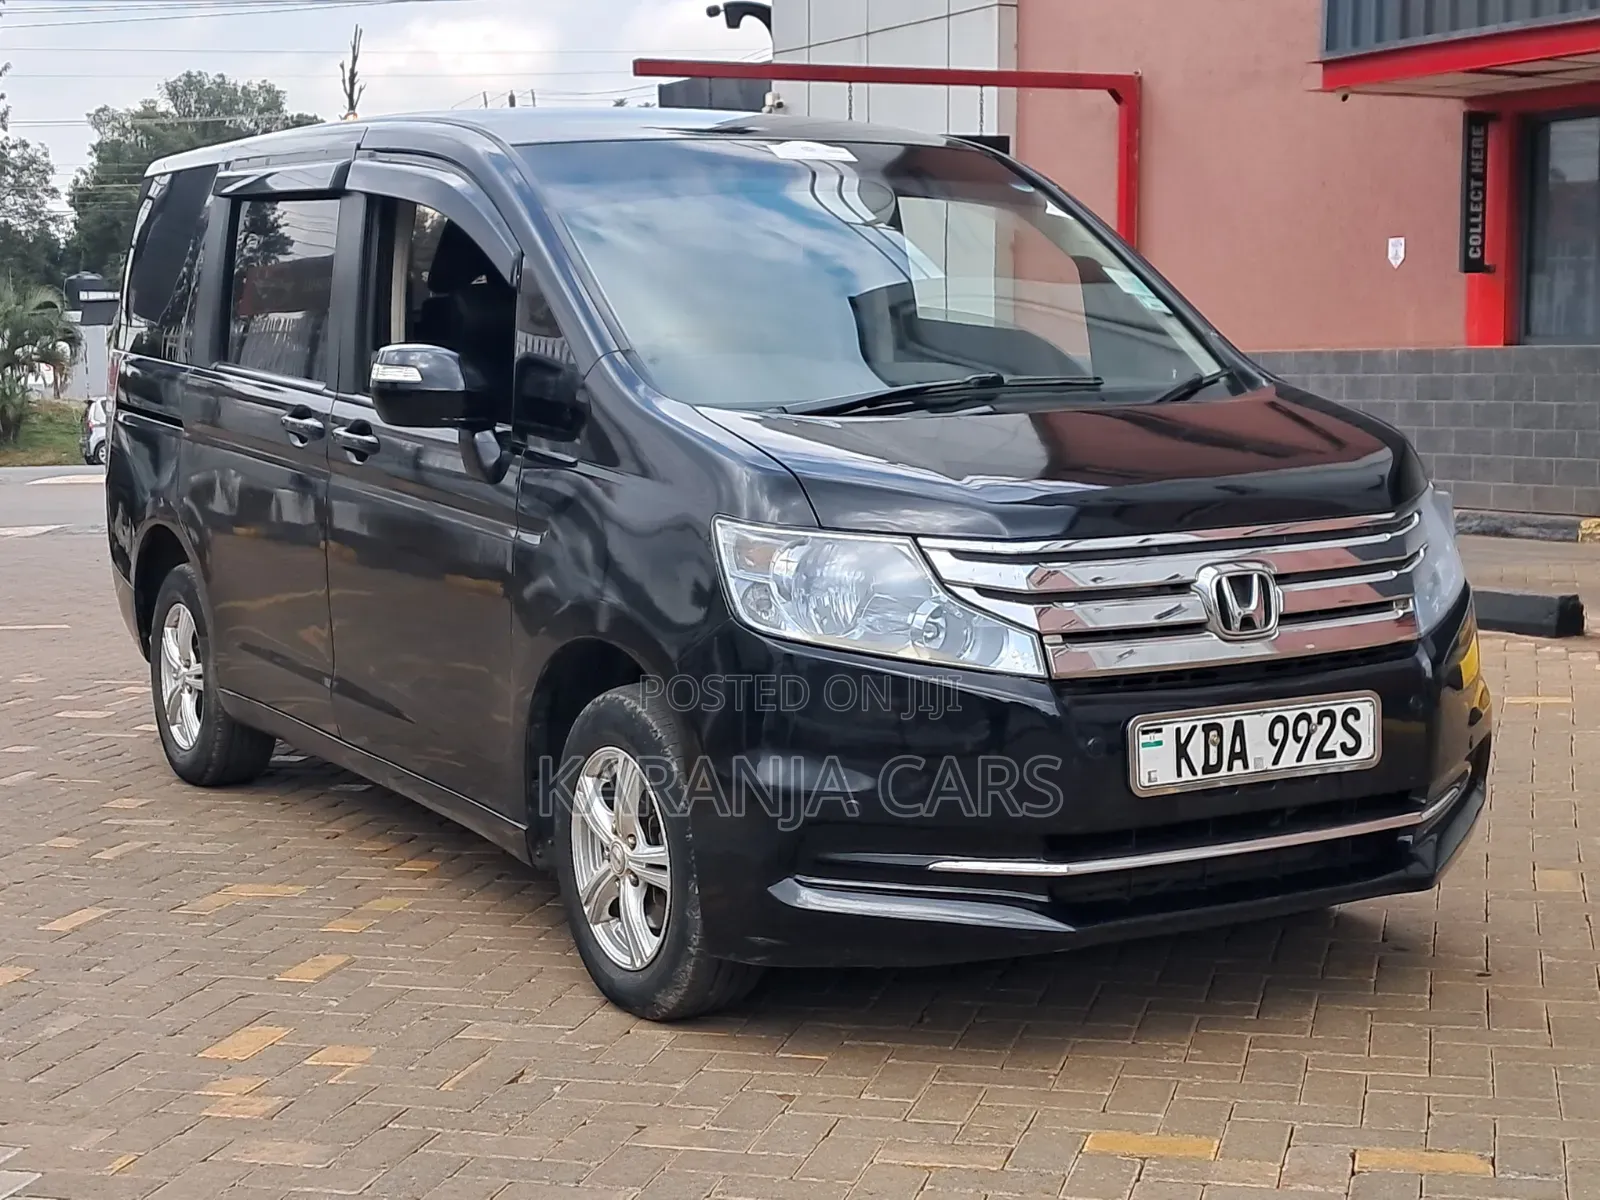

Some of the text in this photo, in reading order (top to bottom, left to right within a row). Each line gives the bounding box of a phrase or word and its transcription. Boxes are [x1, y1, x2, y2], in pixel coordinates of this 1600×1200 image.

[1468, 125, 1485, 259] COLLECT HERE
[1174, 721, 1249, 779] KDA
[1267, 706, 1362, 766] 992S
